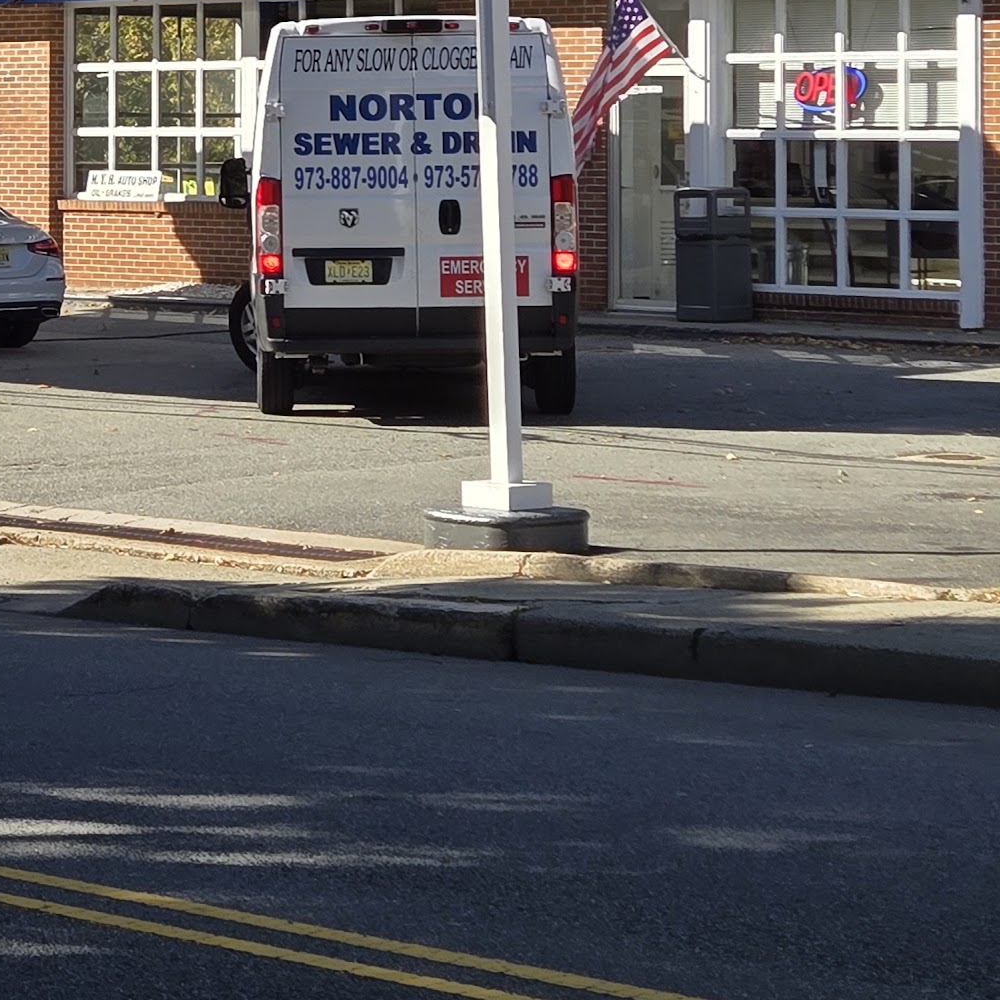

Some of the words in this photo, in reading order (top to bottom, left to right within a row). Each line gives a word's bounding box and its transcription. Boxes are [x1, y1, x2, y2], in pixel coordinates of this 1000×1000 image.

[294, 49, 321, 73] FOR
[324, 48, 354, 72] ANY
[356, 47, 397, 72] SLOW
[399, 47, 418, 71] OR
[422, 46, 478, 71] CLOGGE
[511, 45, 533, 69] AIN
[330, 93, 479, 121] NORTO
[294, 132, 401, 155] SEWER
[410, 131, 432, 155] &
[442, 130, 537, 154] DRIN
[118, 176, 137, 186] AUTO
[138, 176, 157, 186] SHOP
[294, 166, 408, 190] 973-887-9004
[441, 259, 527, 275] EMERY
